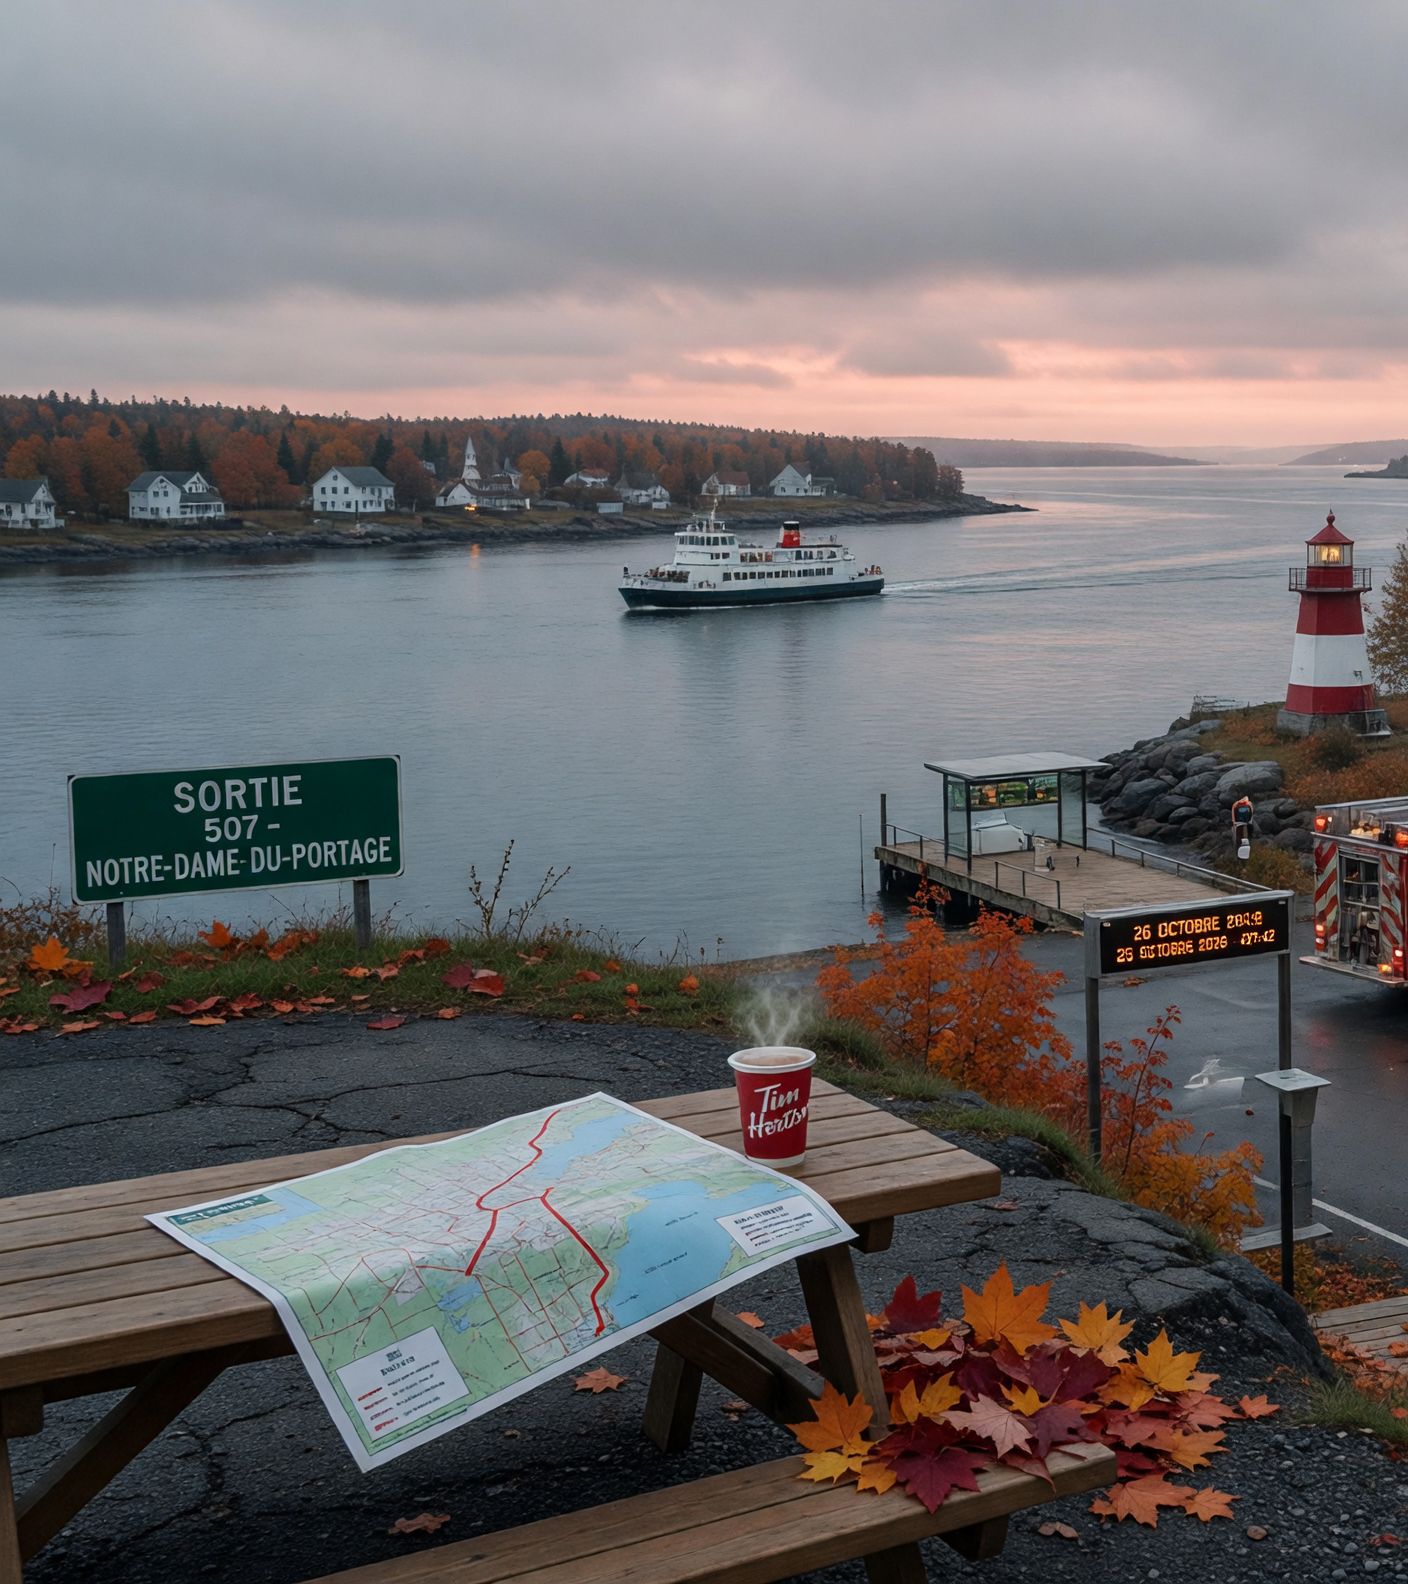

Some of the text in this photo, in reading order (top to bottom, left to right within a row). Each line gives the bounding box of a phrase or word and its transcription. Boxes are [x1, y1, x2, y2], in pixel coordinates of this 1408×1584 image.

[173, 774, 303, 814] SORTIE
[204, 815, 259, 843] 507
[86, 836, 392, 888] NOTRE-DAME-DU-PORTAGE
[1133, 924, 1152, 941] 26
[1158, 916, 1221, 938] OCTOBRE
[754, 1083, 799, 1113] Tim
